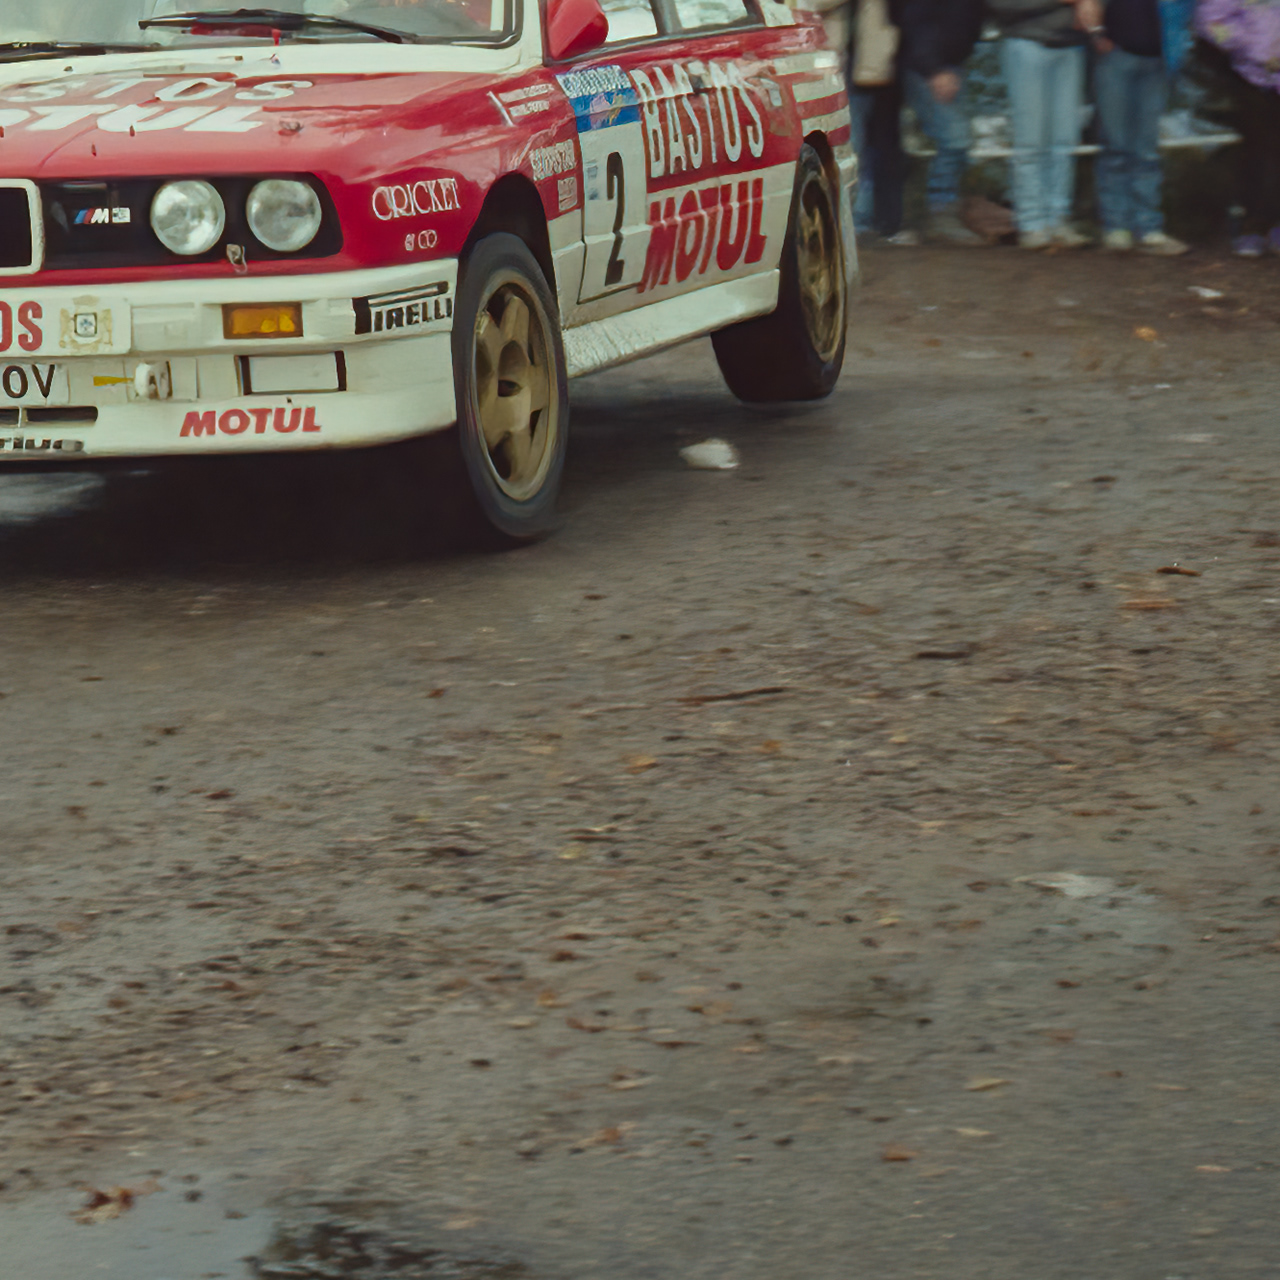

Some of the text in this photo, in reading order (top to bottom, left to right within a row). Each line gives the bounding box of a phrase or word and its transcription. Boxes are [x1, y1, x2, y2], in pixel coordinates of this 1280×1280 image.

[630, 59, 765, 179] BASTOS
[372, 177, 461, 221] CRICKET
[605, 151, 626, 287] 2
[636, 177, 768, 294] MOTUL
[351, 280, 453, 335] PIRELLI
[179, 406, 322, 438] MOTUL
